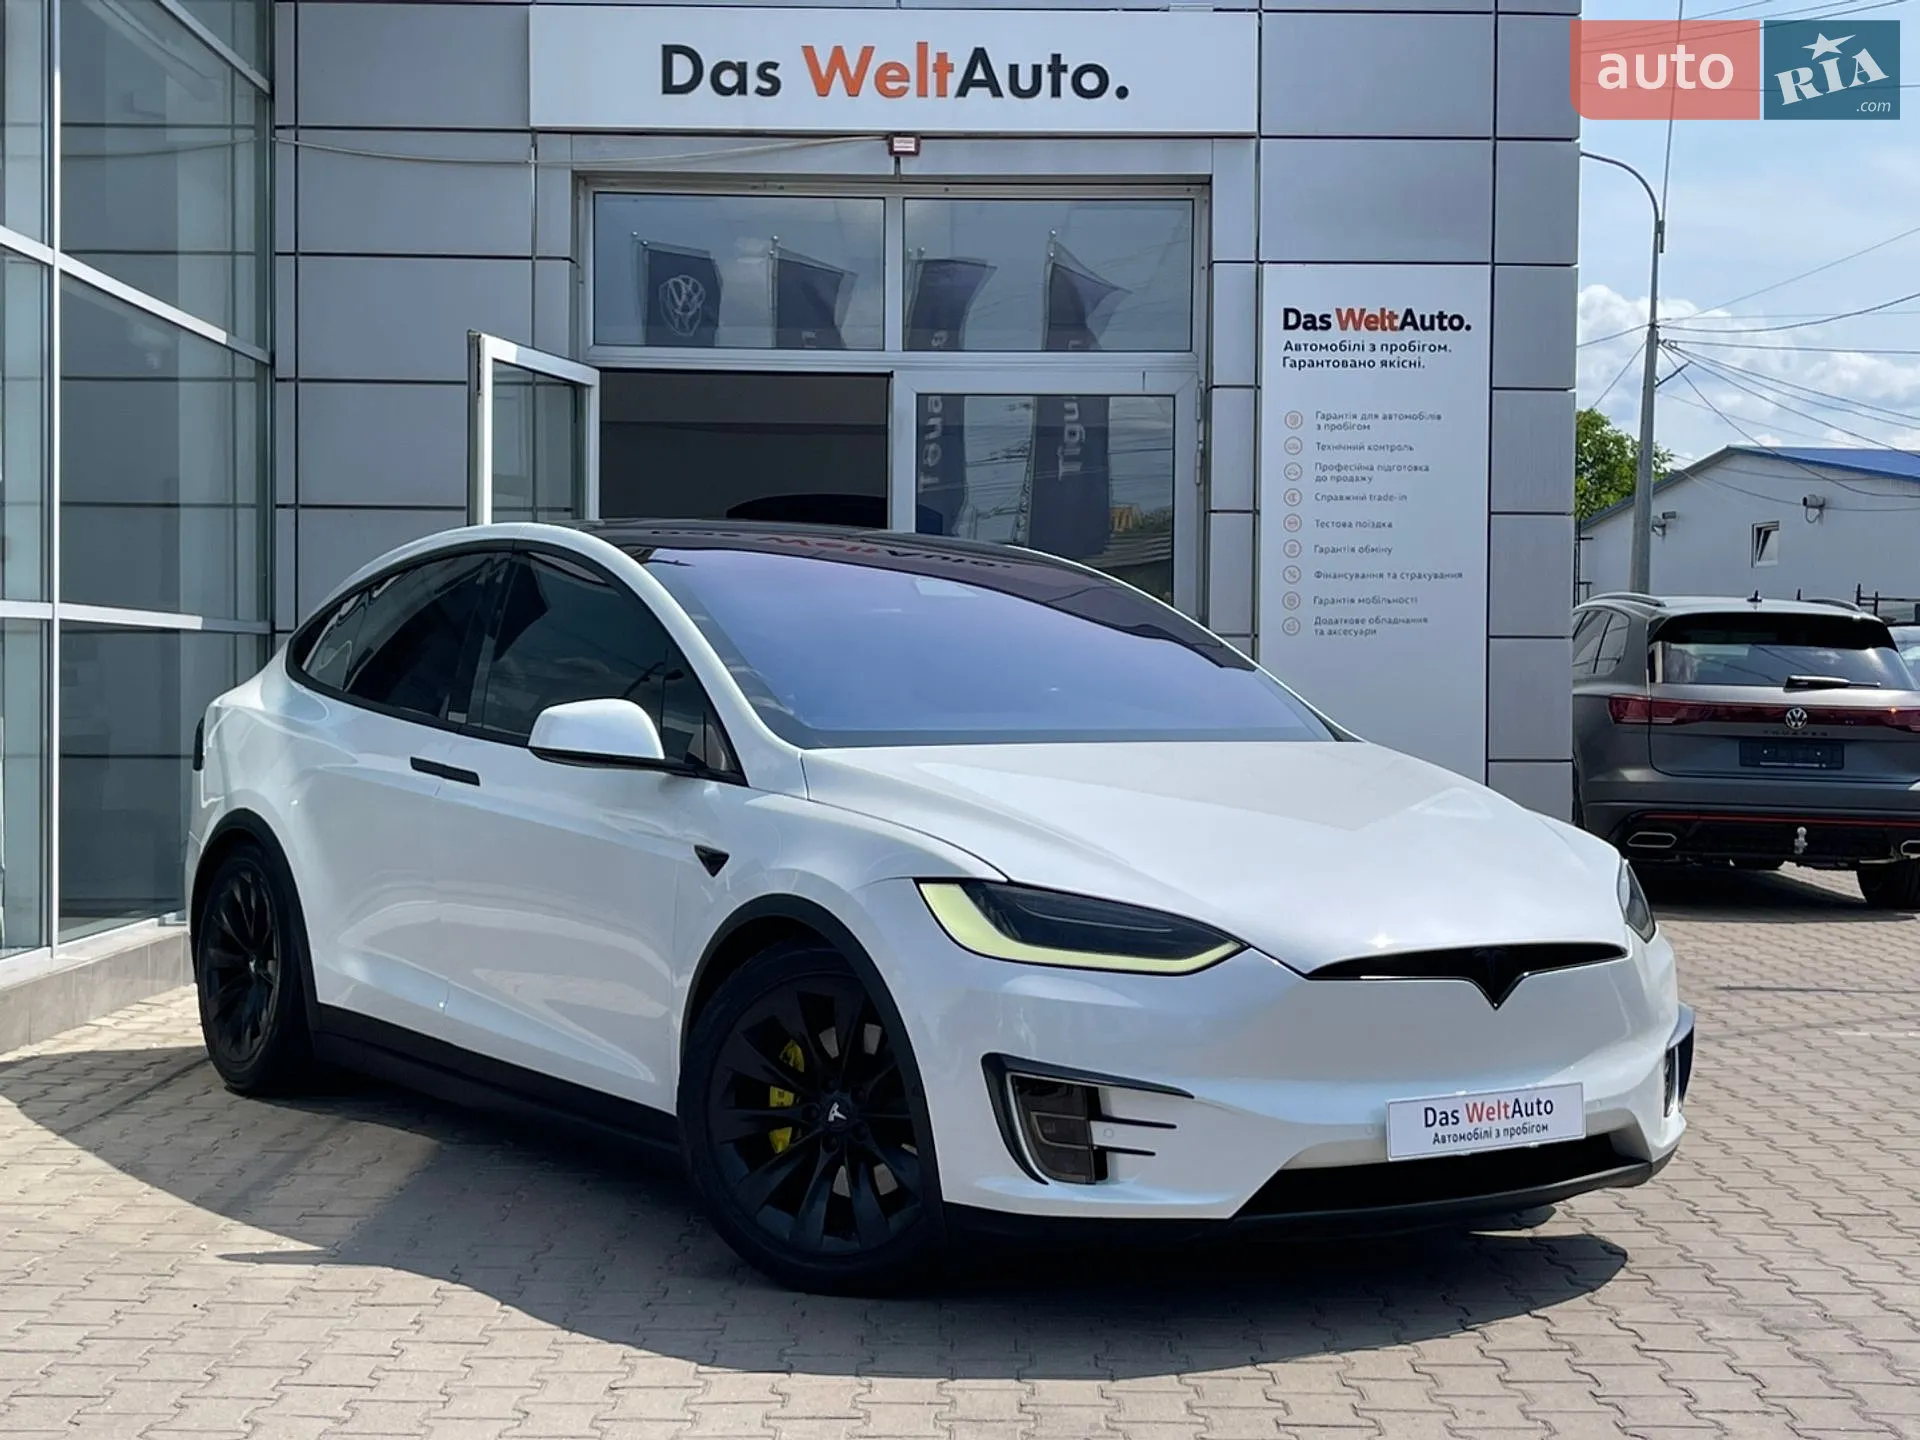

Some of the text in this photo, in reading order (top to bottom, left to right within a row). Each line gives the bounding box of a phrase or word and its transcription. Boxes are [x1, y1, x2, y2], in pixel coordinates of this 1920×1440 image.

[661, 41, 1130, 100] Das WeltAuto.
[1283, 307, 1472, 332] Das WeltAuto.
[1283, 340, 1452, 354] Автомобілі з пробігом.
[1282, 356, 1426, 370] Гарантовано якісні.
[1315, 411, 1442, 422] Гарантія для автомобілів
[1324, 421, 1371, 432] пробігом
[1367, 443, 1415, 453] контроль
[1314, 475, 1373, 484] до продажу
[1369, 492, 1408, 501] trade-in
[1314, 519, 1393, 529] Тестова поїздка
[1313, 545, 1356, 556] Гарантія
[1387, 572, 1397, 580] та
[1313, 595, 1356, 606] Гарантія
[1314, 616, 1366, 626] Додаткове
[1314, 628, 1325, 637] та
[1424, 1097, 1554, 1128] Das WeltAuto
[1432, 1122, 1549, 1145] Автомобілі з пробігом
